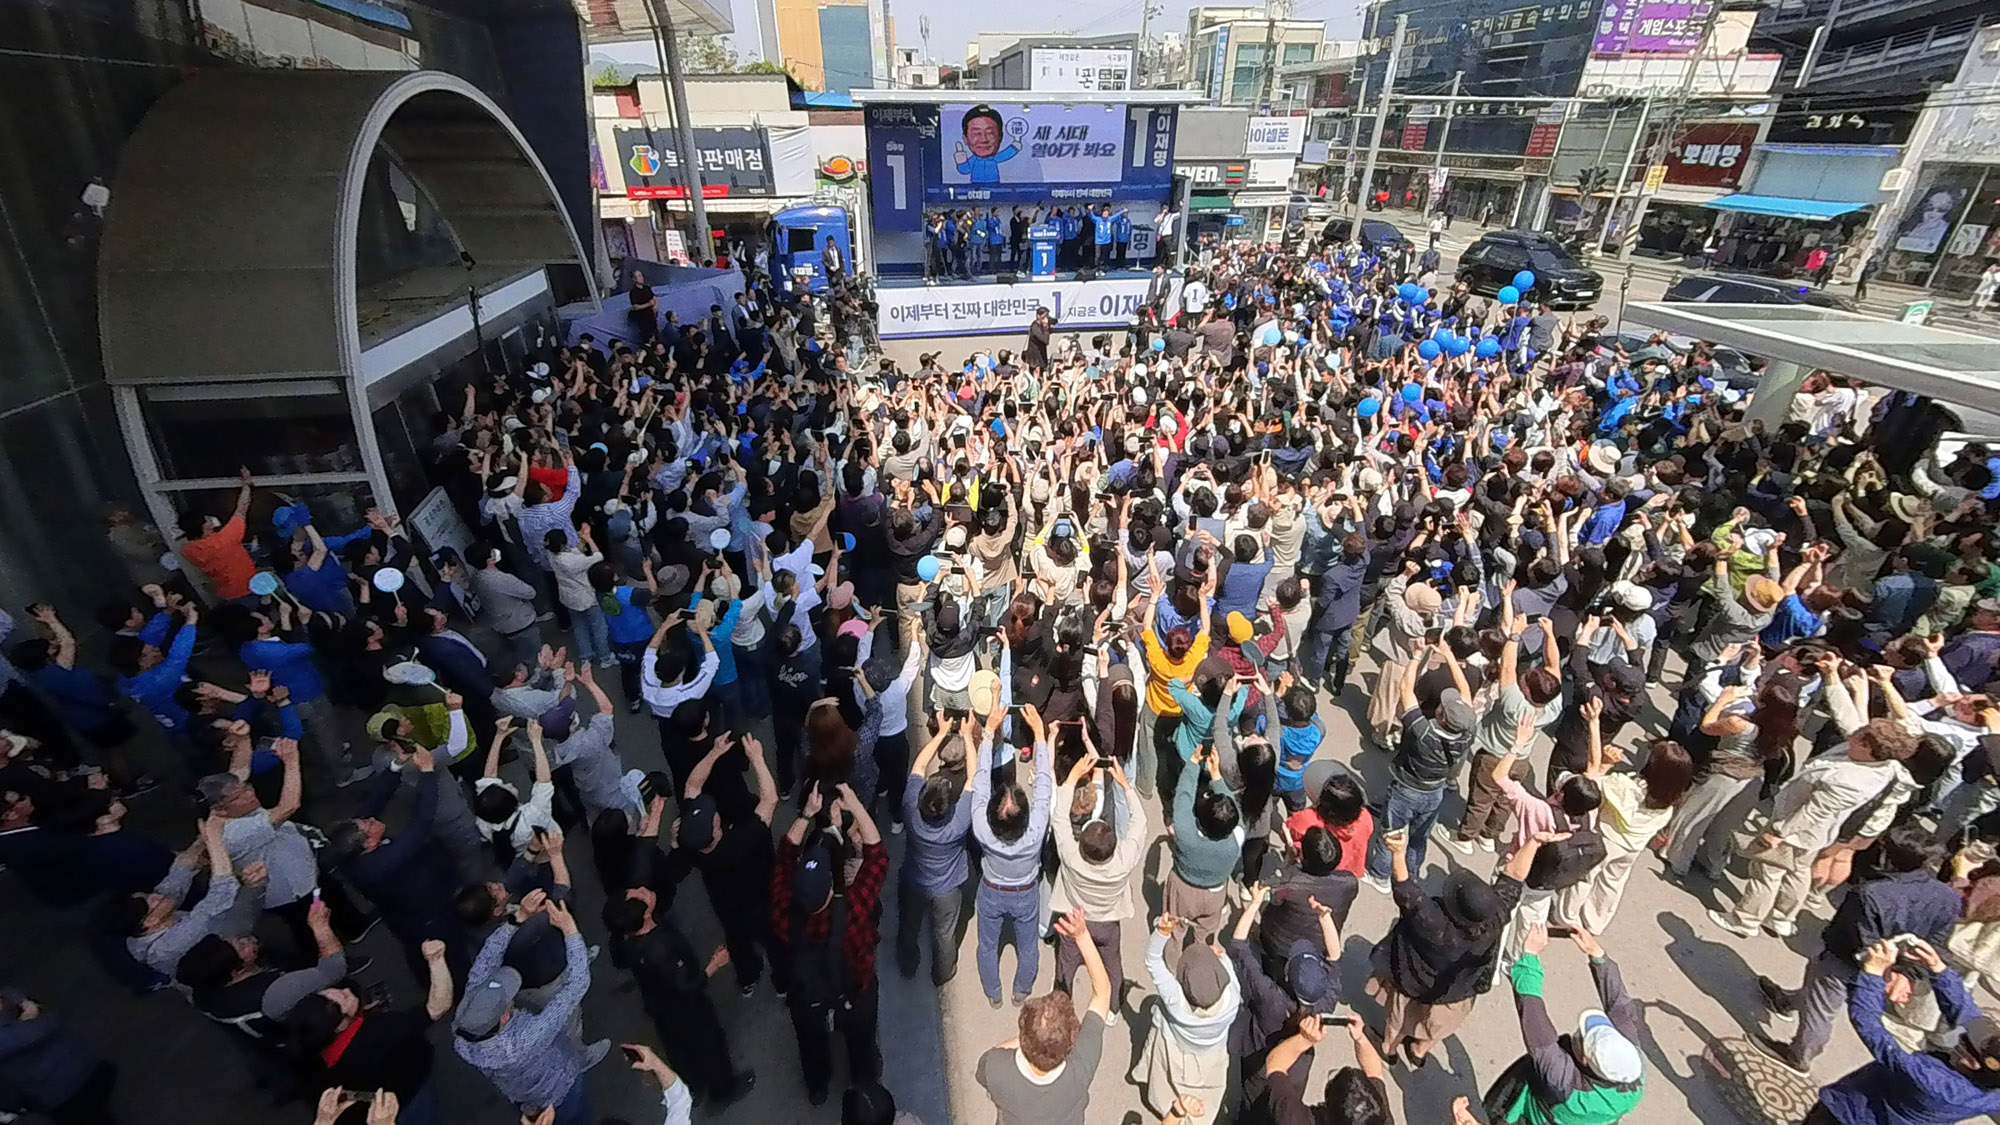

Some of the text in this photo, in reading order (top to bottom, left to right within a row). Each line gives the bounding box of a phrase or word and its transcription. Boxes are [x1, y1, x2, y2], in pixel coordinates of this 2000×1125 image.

[1033, 126, 1090, 141] 새 시대
[1131, 107, 1151, 167] 1
[1153, 115, 1171, 167] 이재명
[664, 148, 764, 171] 복판매점
[1031, 142, 1116, 158] 열어가 봐요
[886, 155, 907, 209] 1
[1041, 252, 1048, 268] 1
[889, 291, 1144, 323] 이제부터 진짜 대한민국 1 지금은 이재
